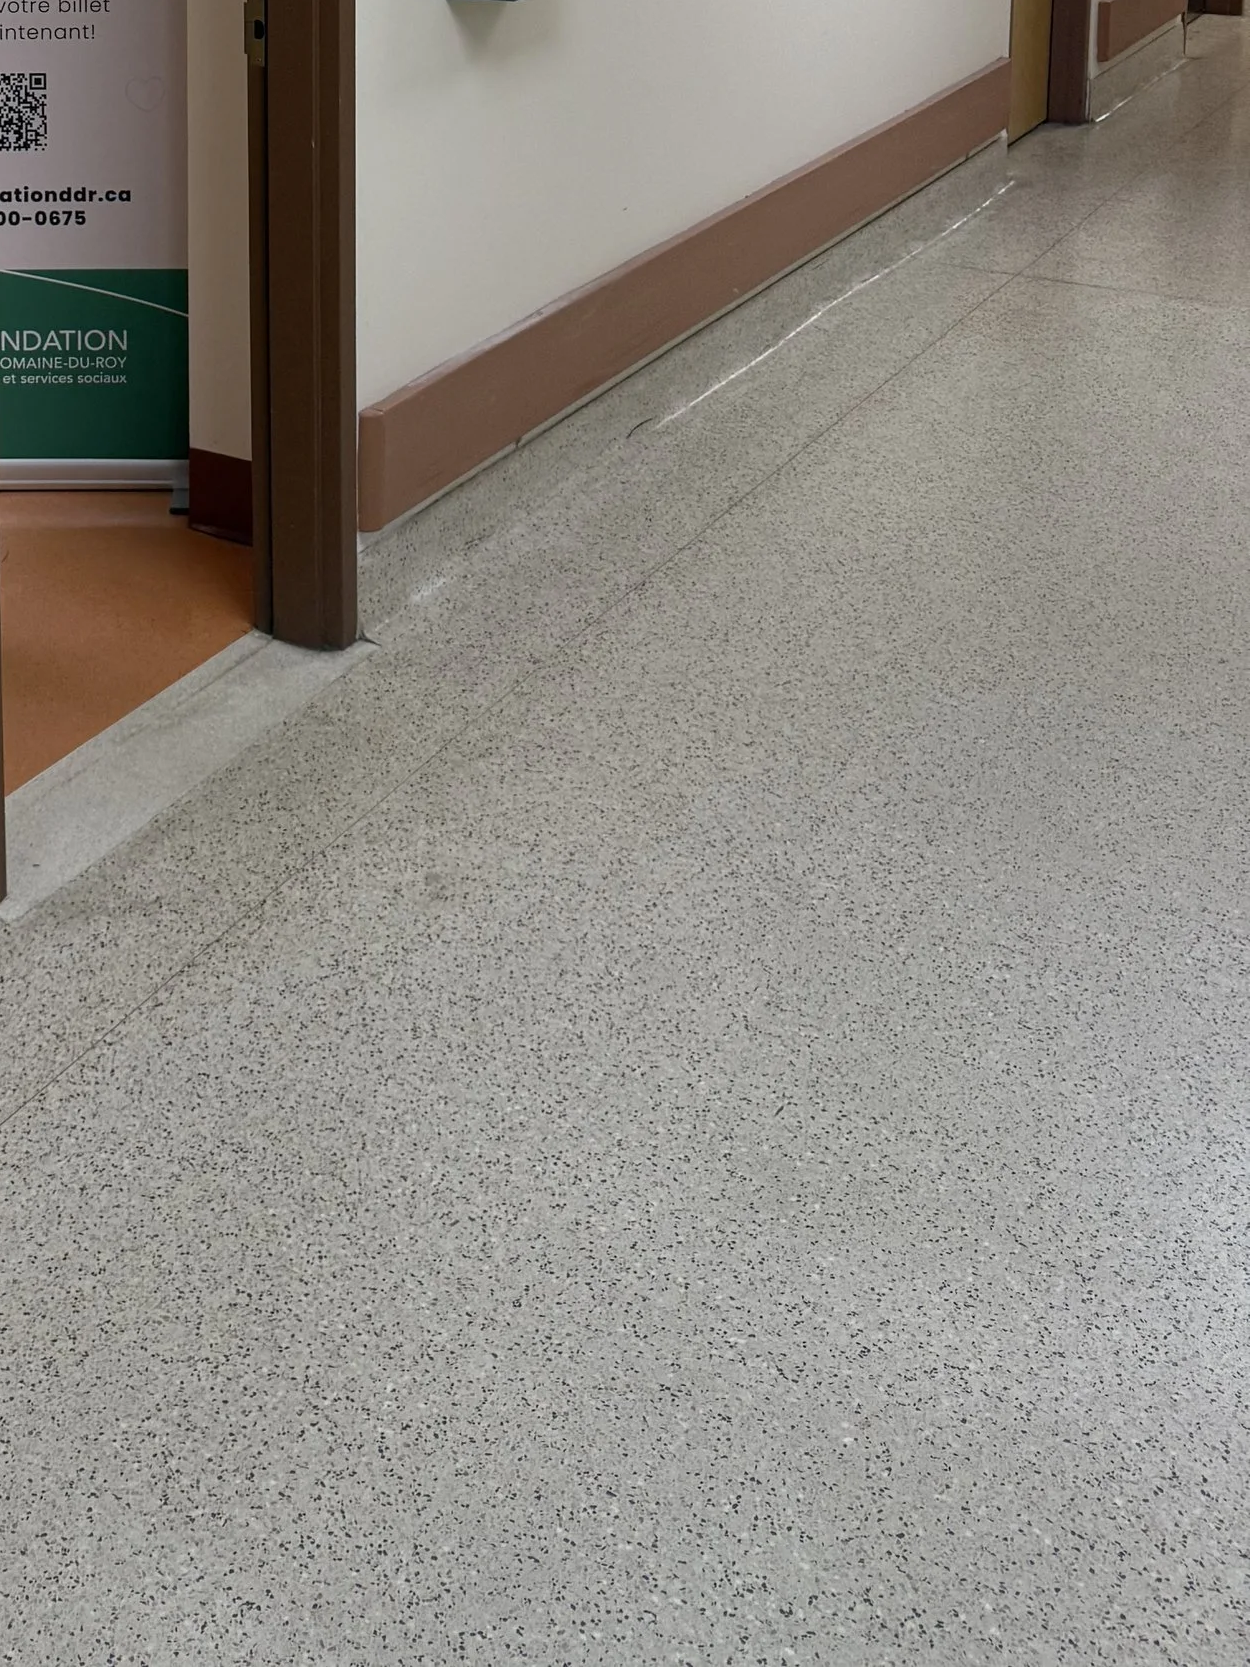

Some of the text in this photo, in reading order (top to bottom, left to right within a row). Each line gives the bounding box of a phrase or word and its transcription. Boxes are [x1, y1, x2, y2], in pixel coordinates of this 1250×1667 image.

[2, 374, 16, 384] et
[20, 371, 74, 385] services
[77, 370, 128, 384] sociaux
